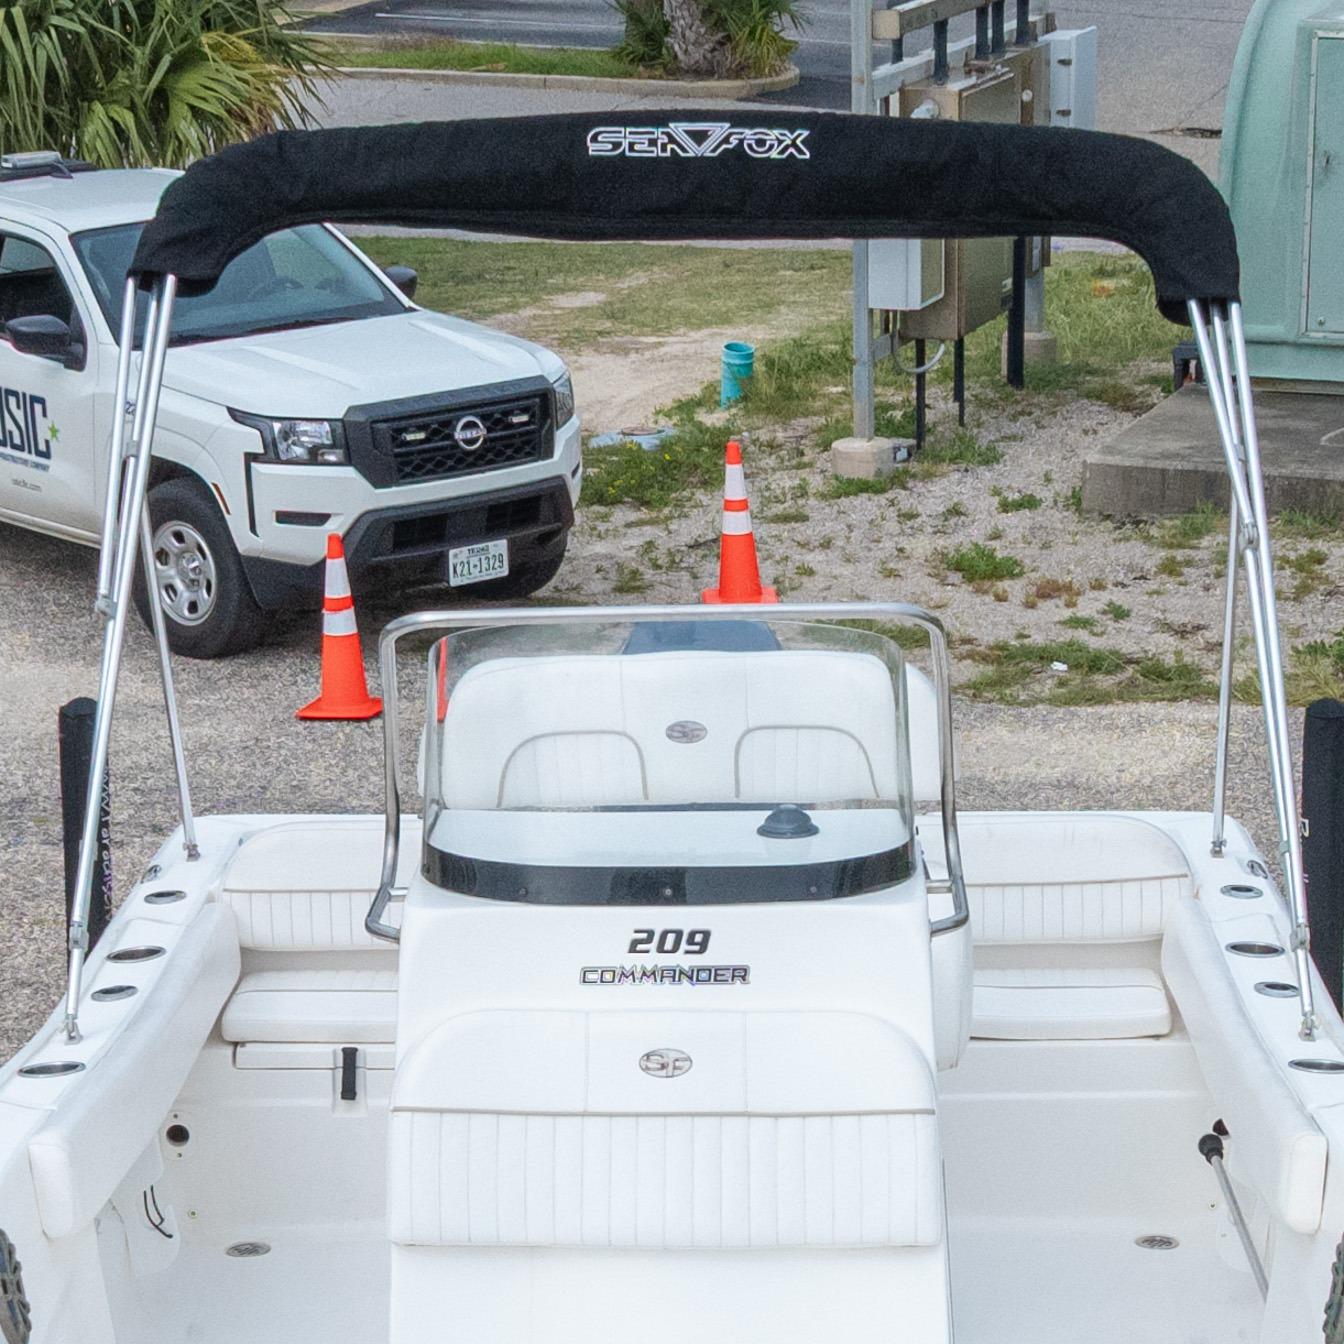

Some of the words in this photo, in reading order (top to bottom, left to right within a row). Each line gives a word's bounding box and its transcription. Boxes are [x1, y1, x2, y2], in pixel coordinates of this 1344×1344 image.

[452, 552, 504, 579] K21-1329
[627, 928, 712, 955] 209
[581, 965, 751, 985] COMMANDER
